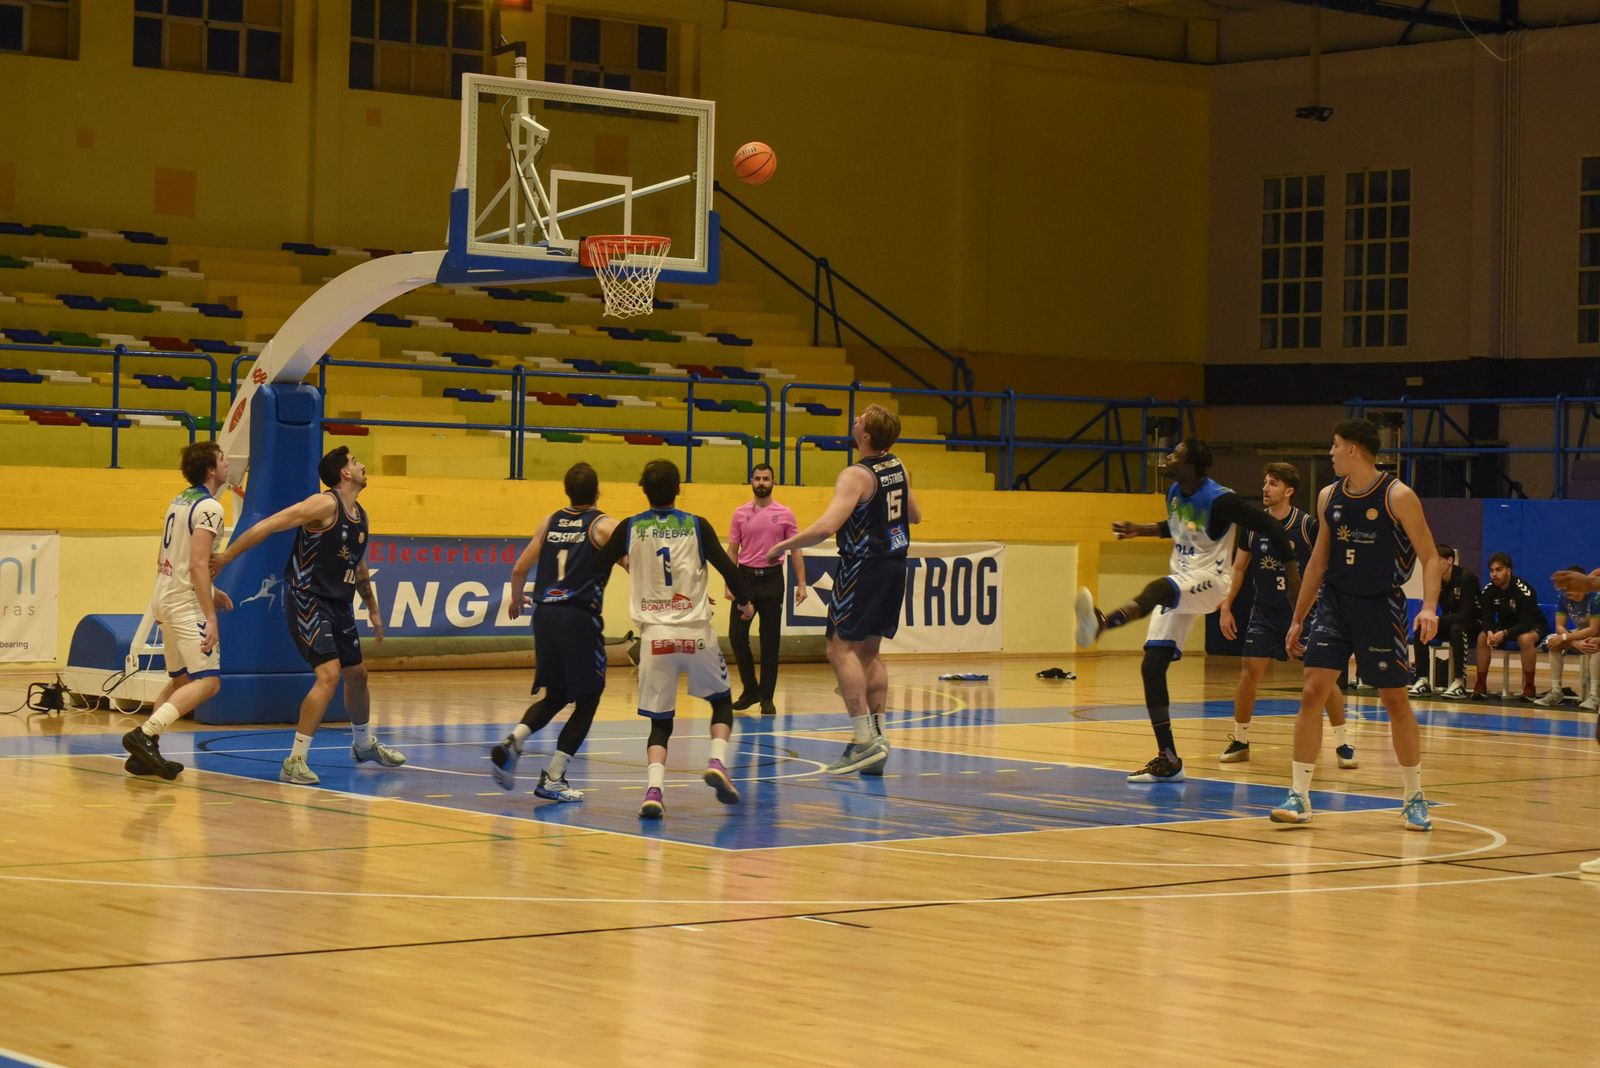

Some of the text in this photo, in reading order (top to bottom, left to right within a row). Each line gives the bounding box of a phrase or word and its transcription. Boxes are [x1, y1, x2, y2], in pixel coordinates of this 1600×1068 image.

[887, 489, 902, 522] 15
[652, 528, 688, 539] RUEDA
[368, 541, 520, 564] Electricid
[1346, 549, 1355, 565] 5
[556, 549, 569, 581] 1
[656, 546, 673, 587] 1
[1276, 576, 1286, 591] 3
[640, 602, 693, 612] BONACHELA
